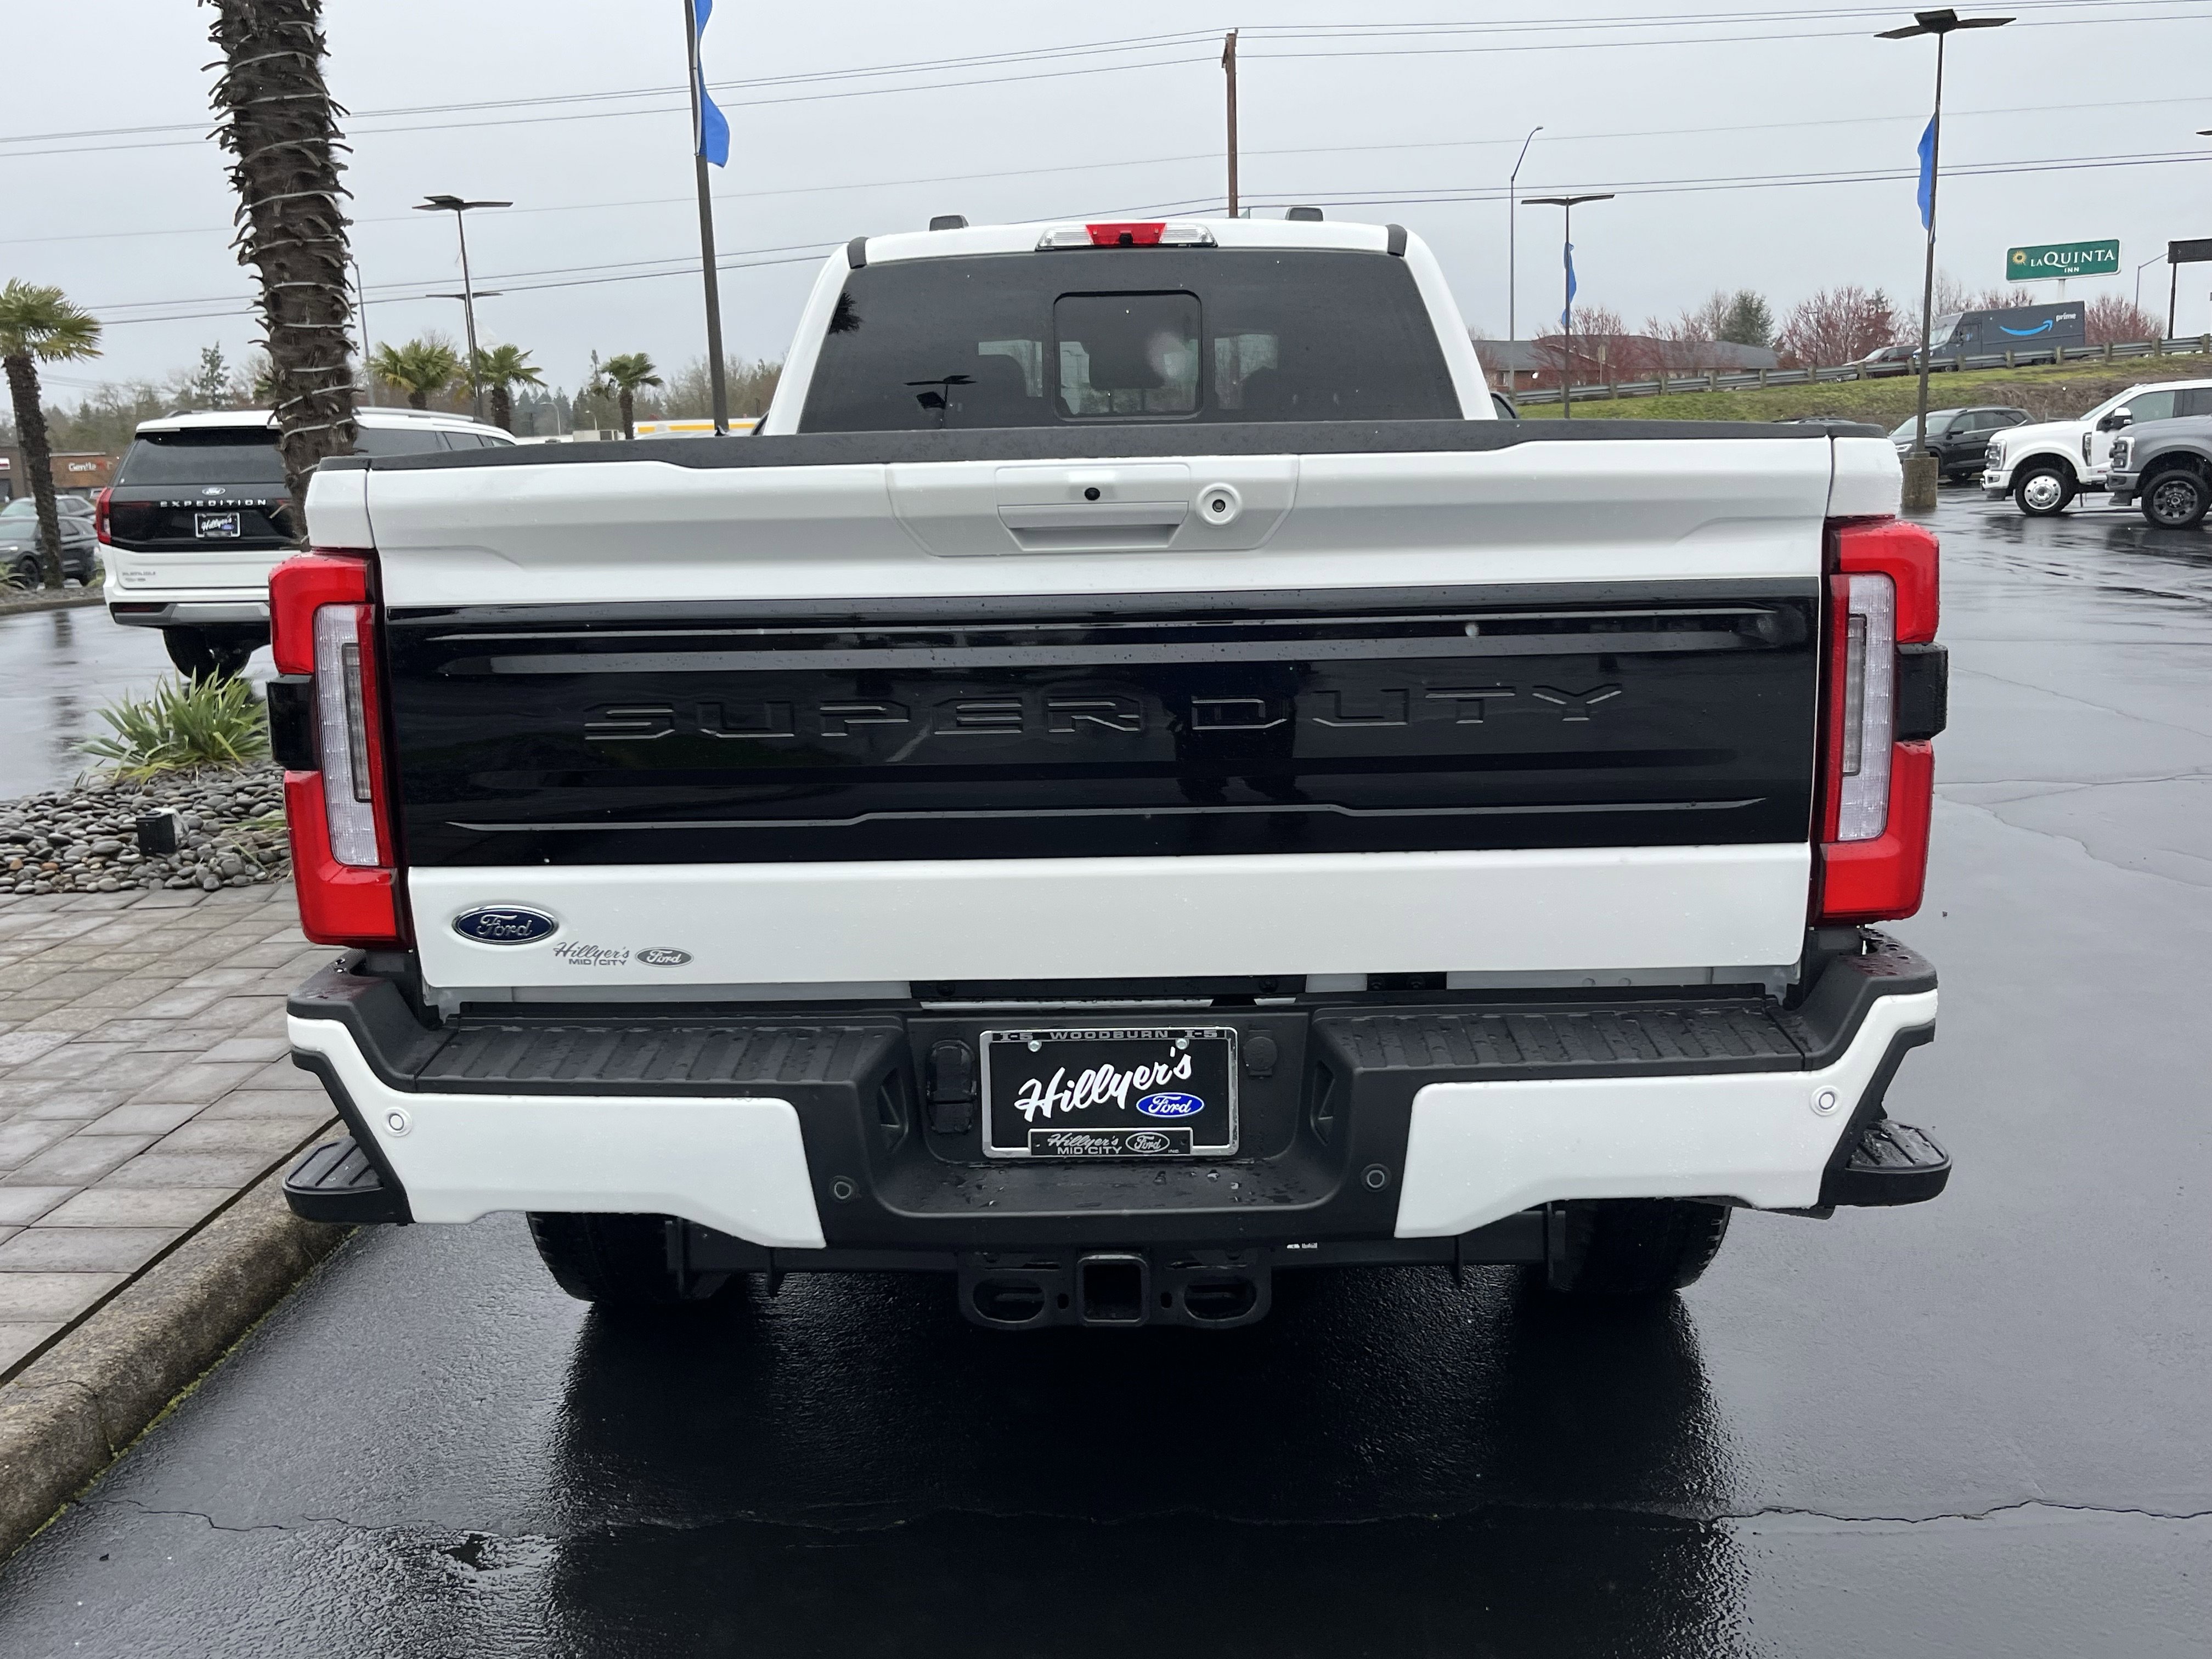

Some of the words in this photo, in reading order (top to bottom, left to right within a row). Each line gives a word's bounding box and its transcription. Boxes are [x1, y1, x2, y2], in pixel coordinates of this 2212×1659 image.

[2030, 258, 2043, 267] LA
[2043, 249, 2116, 268] QUINTA
[2056, 312, 2076, 322] prime
[160, 499, 266, 507] EXPEDITION
[583, 696, 1141, 741] SUPER
[1190, 684, 1622, 730] DUTY
[476, 913, 533, 936] Ford
[553, 941, 630, 966] Hillyer's
[646, 949, 682, 963] Ford
[1000, 1032, 1034, 1041] I-5
[1049, 1031, 1168, 1040] WOODBURN
[1184, 1030, 1218, 1038] I-5
[1014, 1046, 1192, 1122] Hillyer's
[1148, 1097, 1192, 1113] Ford
[1047, 1132, 1119, 1150] Hillyer's
[1134, 1135, 1161, 1150] Ford
[1057, 1147, 1083, 1155] MID
[1088, 1146, 1122, 1155] CITY
